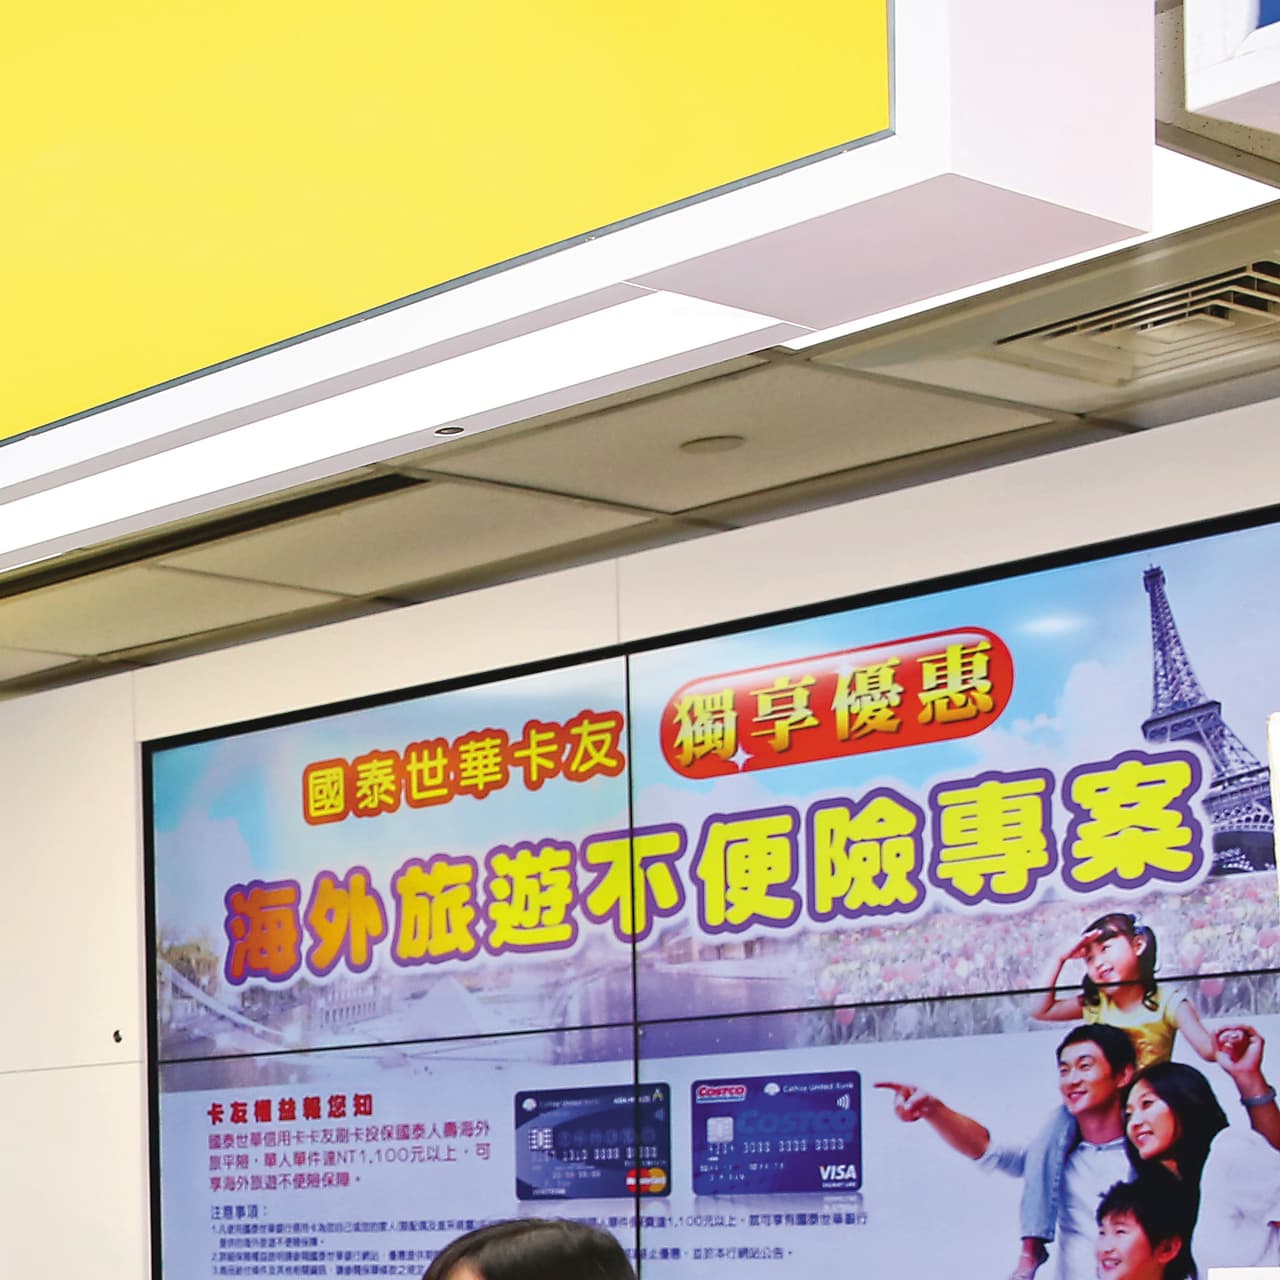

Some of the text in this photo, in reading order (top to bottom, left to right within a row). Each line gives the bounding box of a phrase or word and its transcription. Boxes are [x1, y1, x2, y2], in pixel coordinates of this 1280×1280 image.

[673, 640, 994, 768] 獨享優惠
[306, 716, 622, 821] 國泰世華卡友
[226, 752, 1204, 986] 海外旅遊不便險專案
[819, 1165, 857, 1181] VISA
